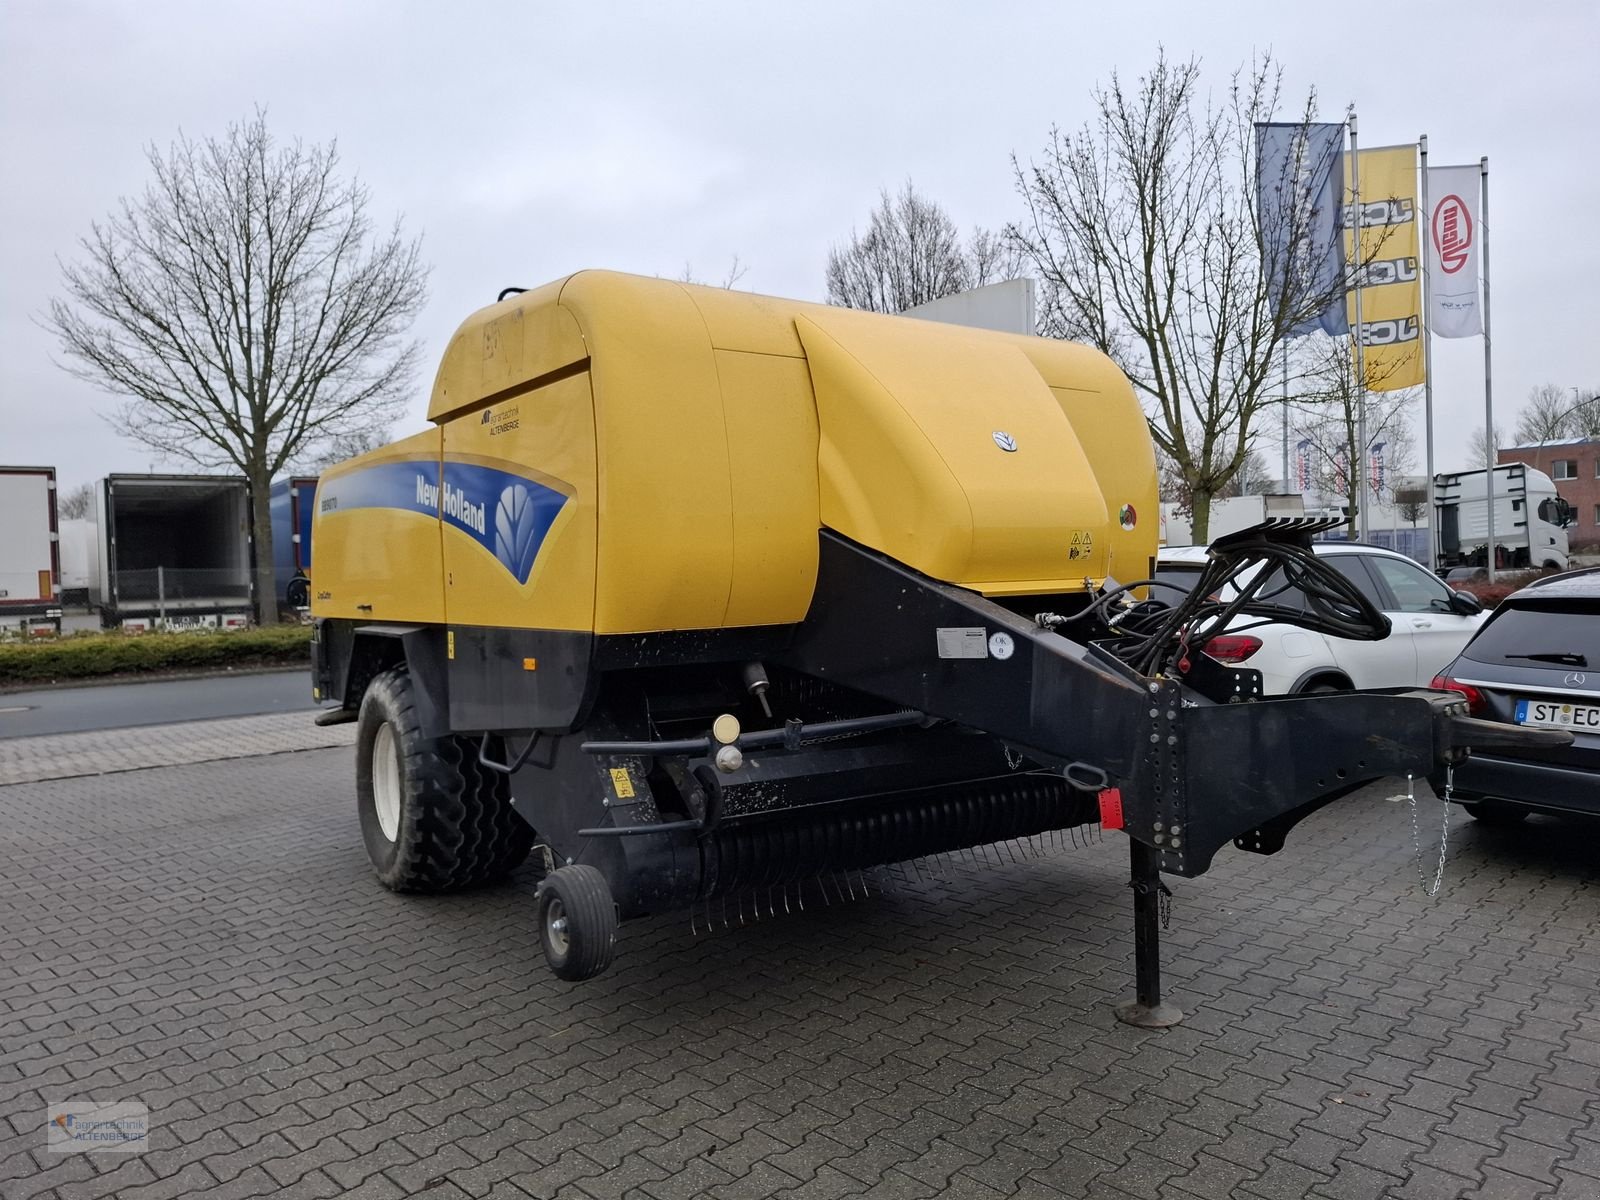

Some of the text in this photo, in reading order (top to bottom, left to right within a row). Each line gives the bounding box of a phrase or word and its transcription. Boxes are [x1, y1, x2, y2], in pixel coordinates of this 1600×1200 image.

[490, 419, 520, 436] ALTENBERGE
[416, 475, 486, 536] New Holland
[1534, 704, 1560, 722] ST
[1573, 708, 1599, 726] EC
